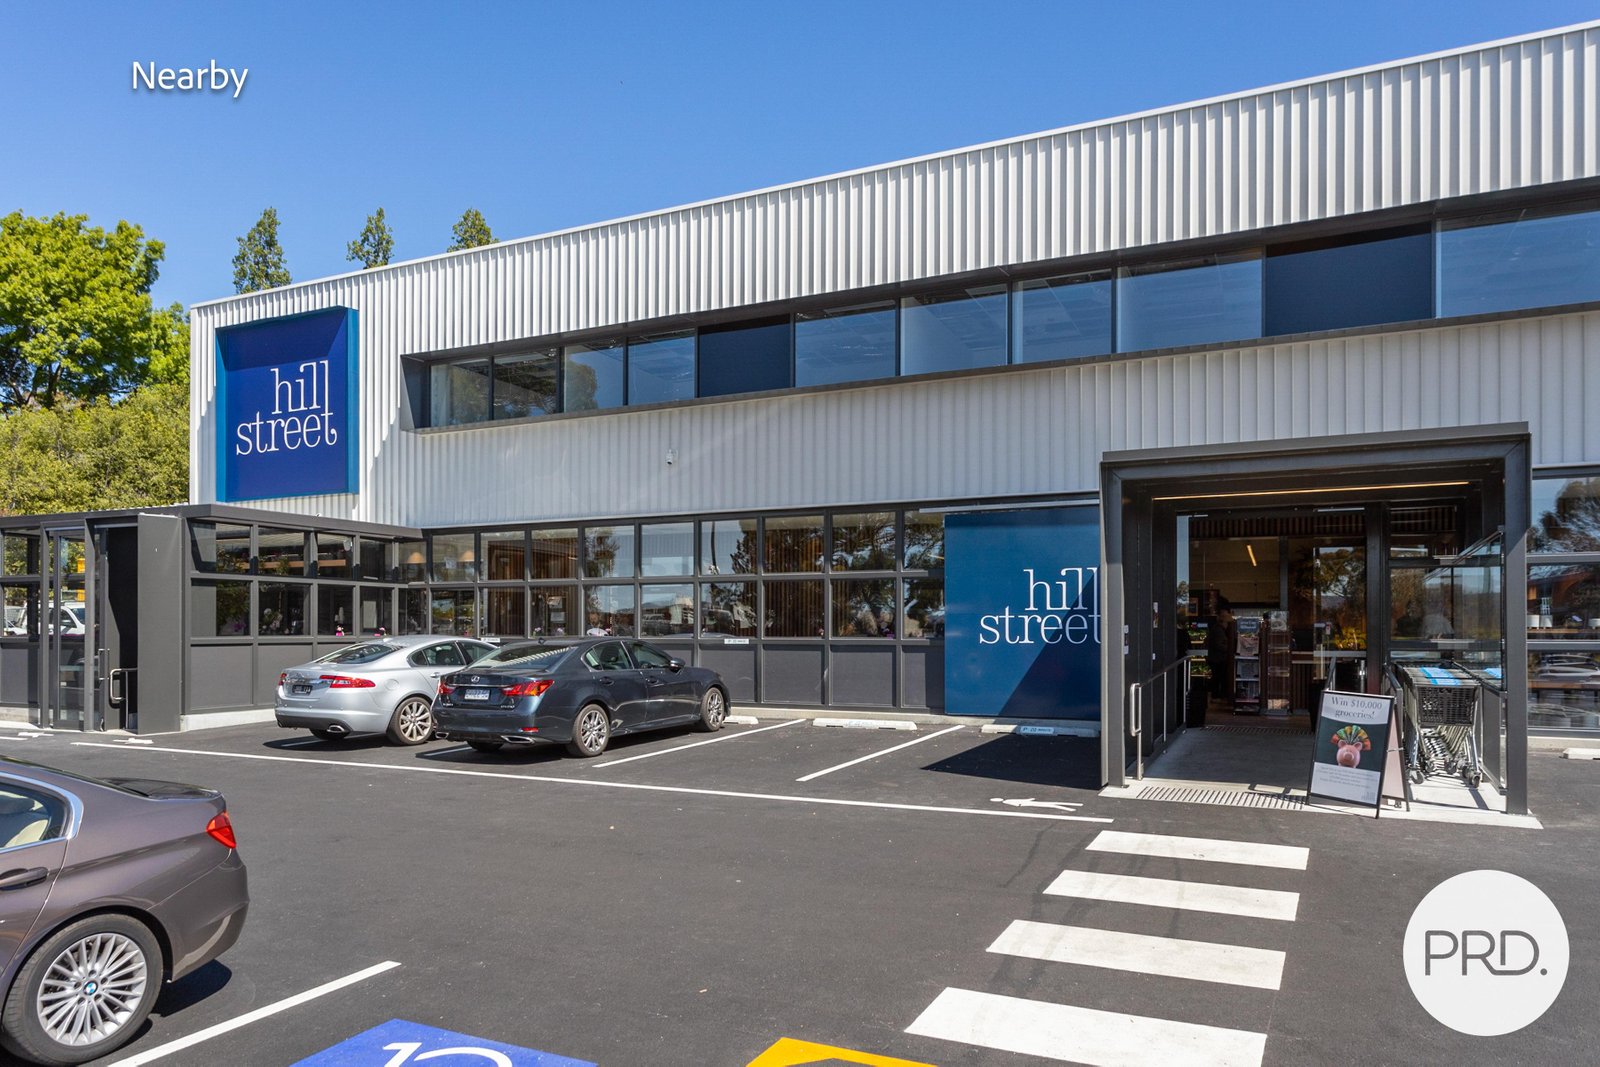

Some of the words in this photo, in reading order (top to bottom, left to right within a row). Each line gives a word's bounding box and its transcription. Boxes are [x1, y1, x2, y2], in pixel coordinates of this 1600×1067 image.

[270, 359, 329, 415] hill
[236, 411, 338, 455] street
[1023, 567, 1098, 611] hill
[979, 605, 1101, 644] street
[1331, 696, 1348, 706] Win
[1335, 709, 1375, 720] groceries!
